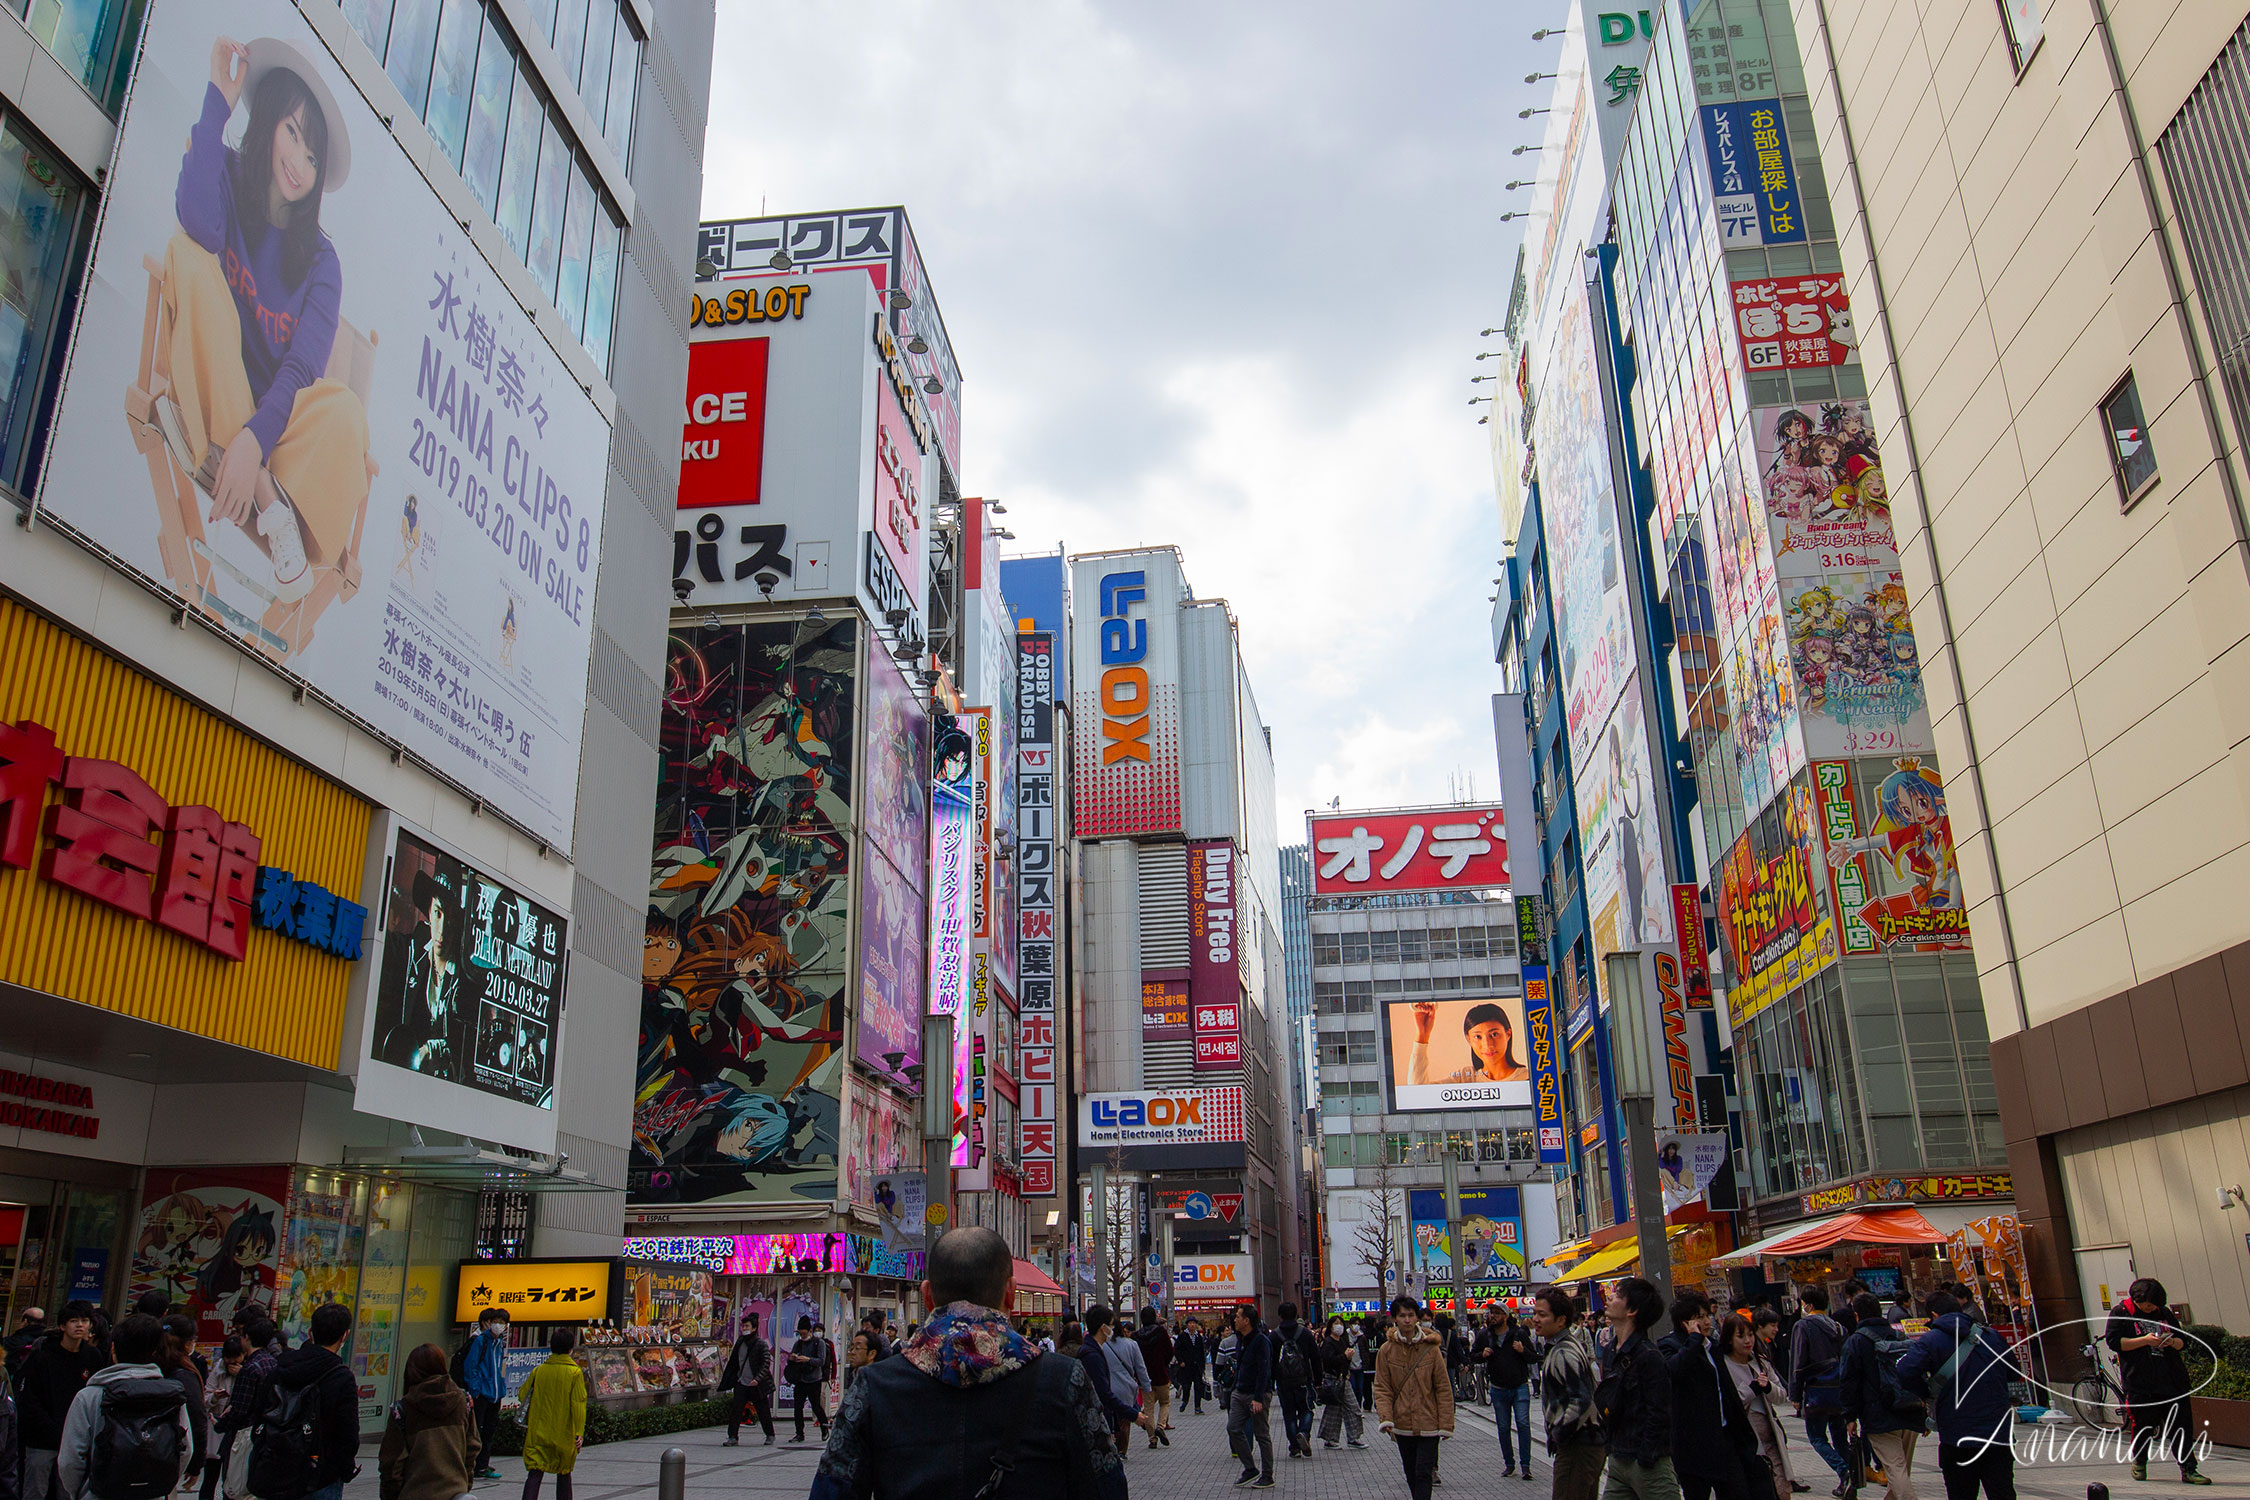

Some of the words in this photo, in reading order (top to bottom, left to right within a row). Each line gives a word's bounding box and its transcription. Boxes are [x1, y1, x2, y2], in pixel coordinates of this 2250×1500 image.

[1740, 72, 1773, 92] 8F
[1713, 107, 1743, 193] レオパレス21
[1750, 109, 1796, 235] お部屋探しは
[1721, 216, 1757, 238] 7F
[226, 248, 298, 344] BRTIS
[428, 270, 550, 440] 水樹奈々
[1750, 347, 1778, 364] 6F
[1785, 338, 1828, 351] 秋葉原
[417, 334, 493, 475] NANA
[503, 435, 572, 552] CLIPS
[577, 517, 590, 573] 8
[409, 417, 514, 556] 2019.03.20
[518, 530, 542, 585] ON
[545, 558, 584, 628] SALE
[1822, 553, 1855, 567] 3.16
[1036, 641, 1050, 706] HOBBY
[1020, 640, 1036, 739] PARADISE
[978, 717, 989, 756] DVD
[1844, 731, 1895, 752] 3.29
[1816, 763, 1877, 953] カードゲム専門店
[1191, 849, 1204, 899] Flagship
[1205, 848, 1232, 904] Duty
[252, 866, 368, 961] 秋葉原
[476, 883, 557, 955] 松下優也
[1194, 902, 1206, 937] Store
[1207, 908, 1234, 964] Free
[486, 972, 550, 1019] 2019.03.27
[975, 953, 988, 1017] フィギュア
[1142, 984, 1165, 995] 本店
[1528, 982, 1545, 999] 薬
[1142, 995, 1187, 1007] 総合家電
[1199, 1009, 1235, 1028] 免税
[1199, 1041, 1238, 1056] 면세점
[1441, 1088, 1501, 1101] ONODEN
[1090, 1130, 1118, 1140] Home
[1121, 1128, 1174, 1140] Electronics
[1177, 1128, 1204, 1138] Store
[1695, 1154, 1714, 1163] NANA
[1696, 1163, 1716, 1172] CLIPS
[1944, 1176, 2013, 1196] カードキ
[1220, 1199, 1238, 1207] 止まれ
[1494, 1222, 1518, 1244] 迎
[498, 1286, 597, 1304] 銀座ライオン
